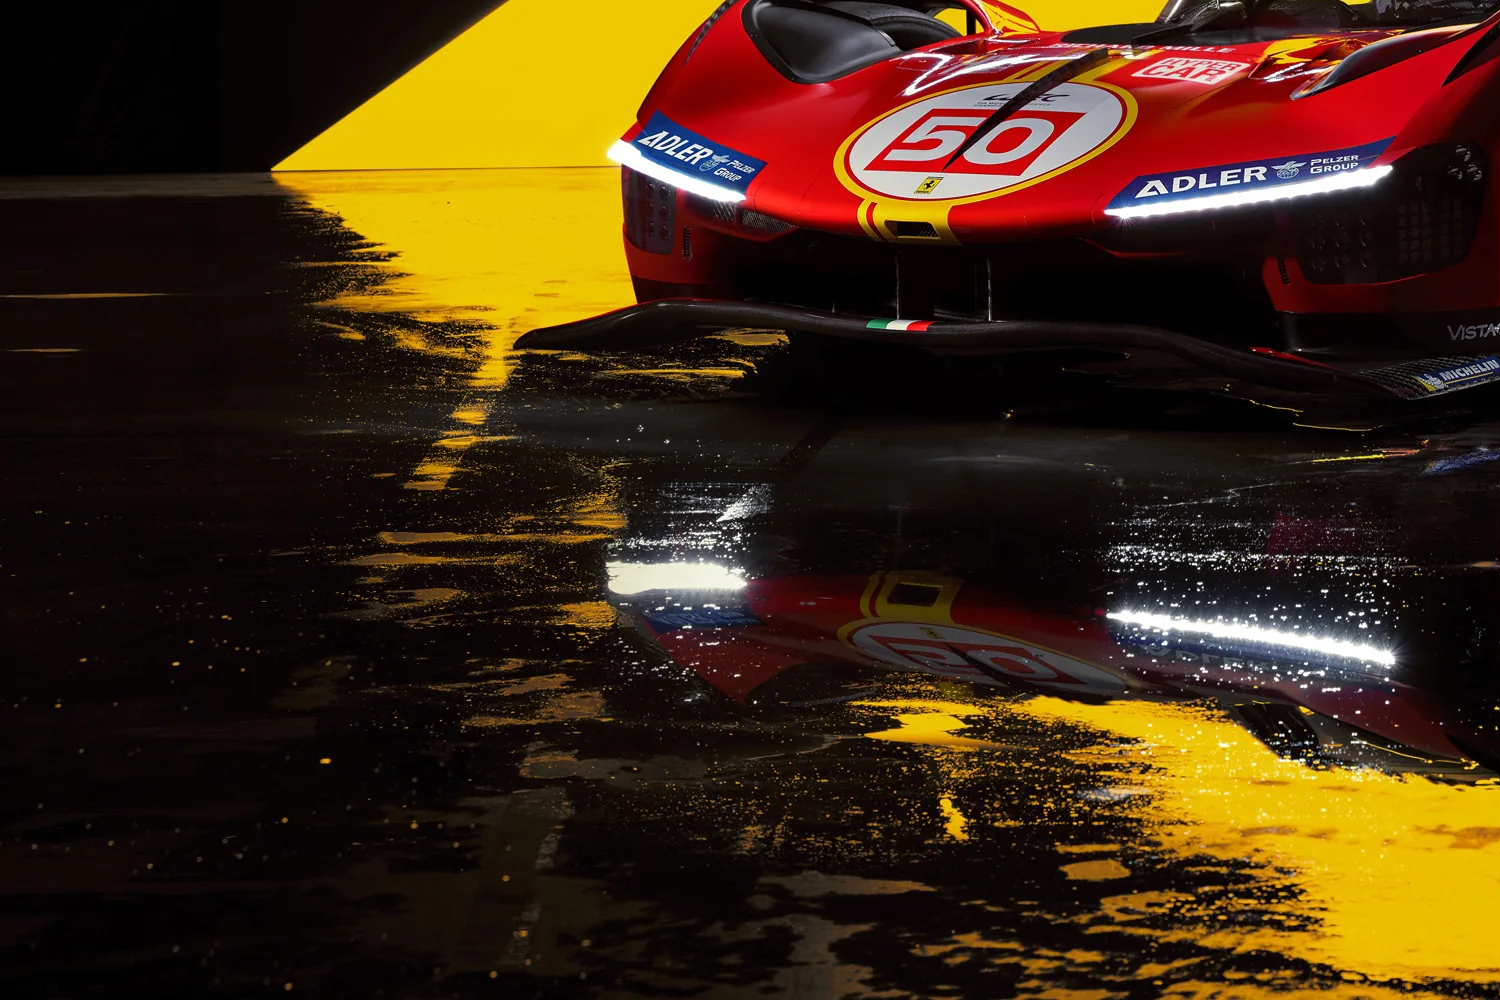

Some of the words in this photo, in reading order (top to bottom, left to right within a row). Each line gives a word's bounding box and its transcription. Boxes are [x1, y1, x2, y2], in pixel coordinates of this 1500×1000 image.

[1160, 45, 1236, 54] MILLE
[1160, 58, 1242, 72] HYPER
[1142, 65, 1223, 82] CAR
[637, 130, 713, 165] ADLER
[885, 115, 1055, 166] 50
[727, 160, 755, 173] PELZER
[1310, 154, 1359, 165] PELZER
[714, 167, 741, 182] GROUP
[1310, 162, 1359, 174] GROUP
[1134, 166, 1268, 199] ADLER
[1439, 359, 1500, 381] MICHELIN
